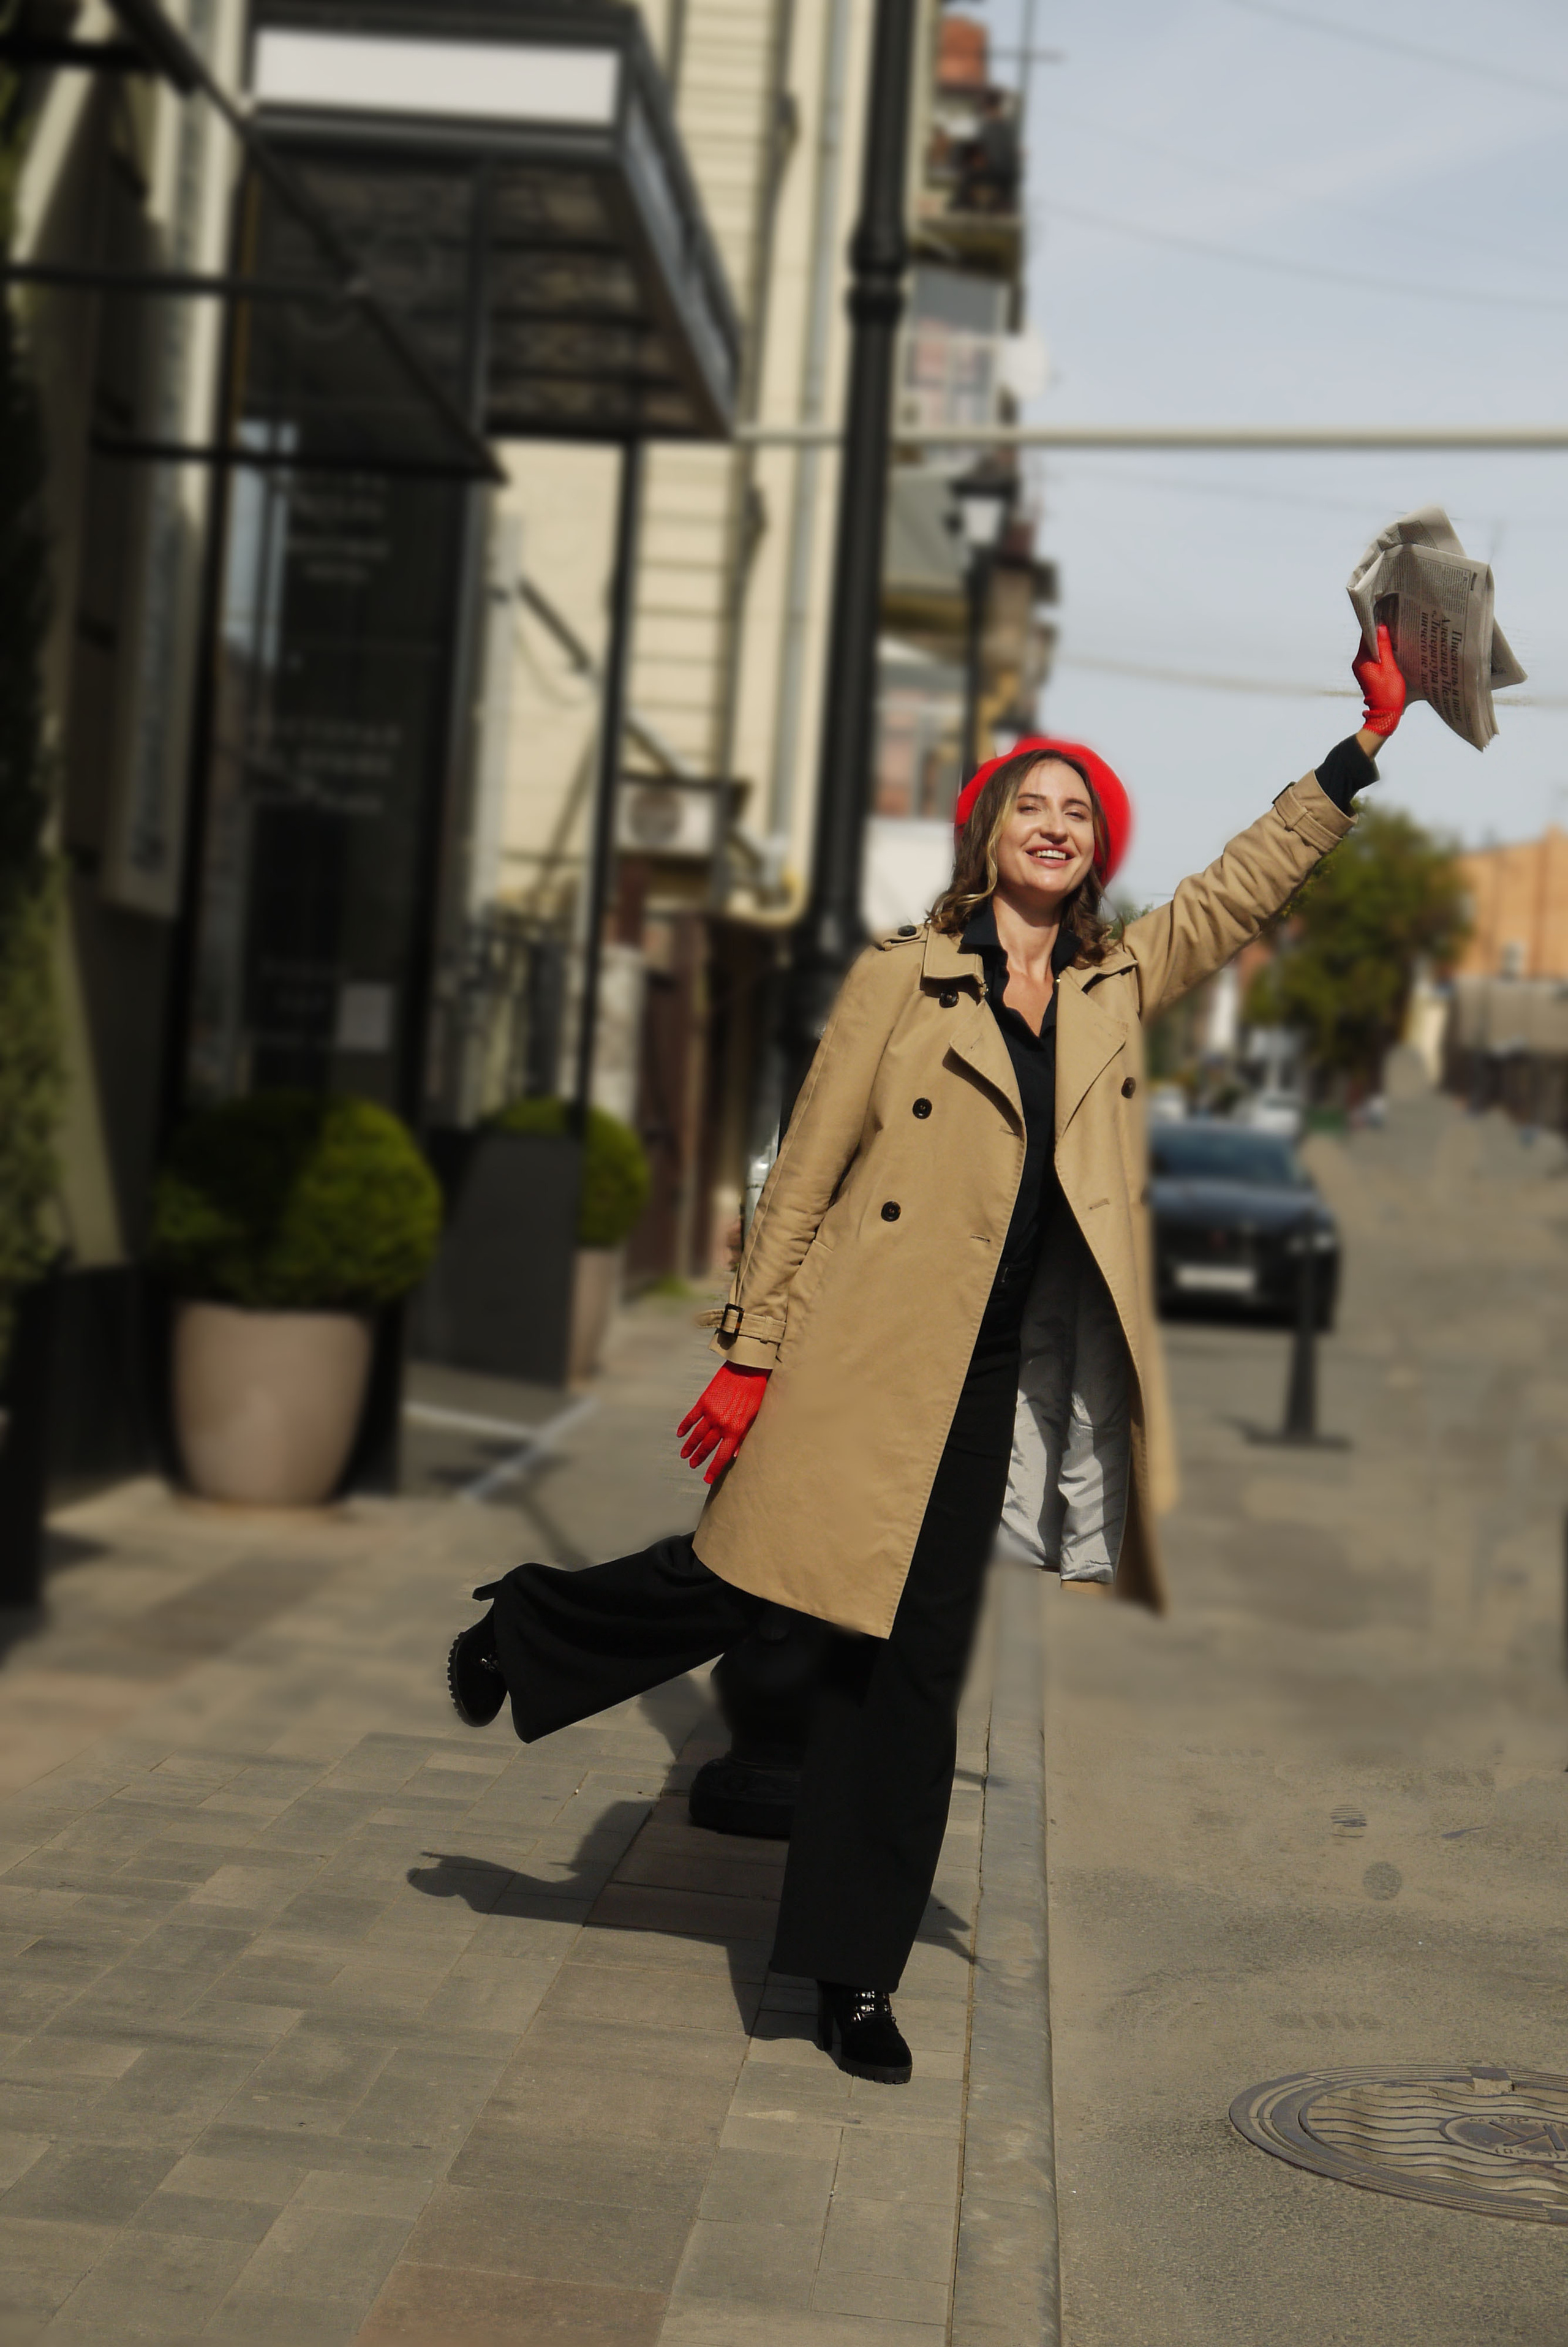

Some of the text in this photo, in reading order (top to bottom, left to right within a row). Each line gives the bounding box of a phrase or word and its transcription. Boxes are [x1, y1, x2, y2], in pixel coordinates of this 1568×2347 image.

[1421, 655, 1428, 668] не
[1429, 610, 1441, 684] «Литература
[1439, 616, 1450, 677] Александр
[1451, 630, 1462, 686] Писатель
[1452, 698, 1462, 721] поэт
